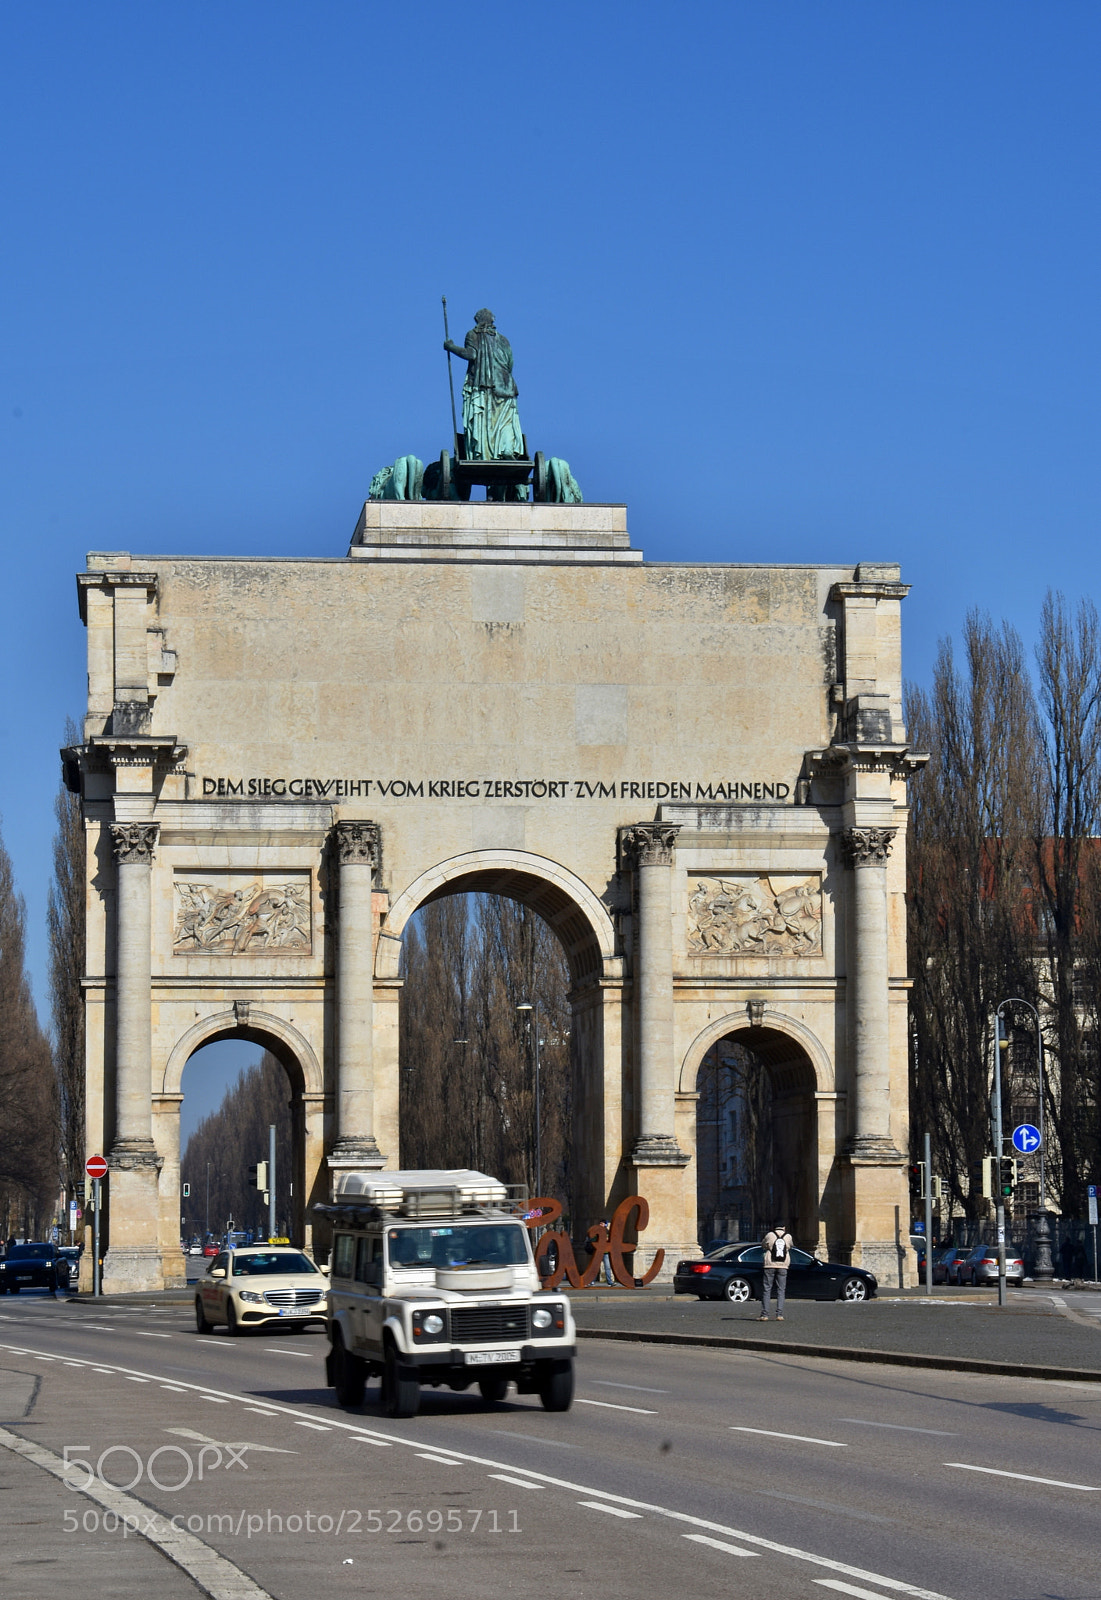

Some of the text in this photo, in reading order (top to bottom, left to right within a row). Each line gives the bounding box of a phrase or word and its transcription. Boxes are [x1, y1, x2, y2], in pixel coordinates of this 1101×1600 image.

[202, 777, 243, 796] DEM
[248, 778, 286, 797] SIEG
[377, 780, 424, 798] VOM
[428, 780, 480, 798] KRIEG
[574, 781, 616, 799] ZVM
[620, 781, 691, 799] FRIEDEN
[695, 782, 790, 799] MAHNEND
